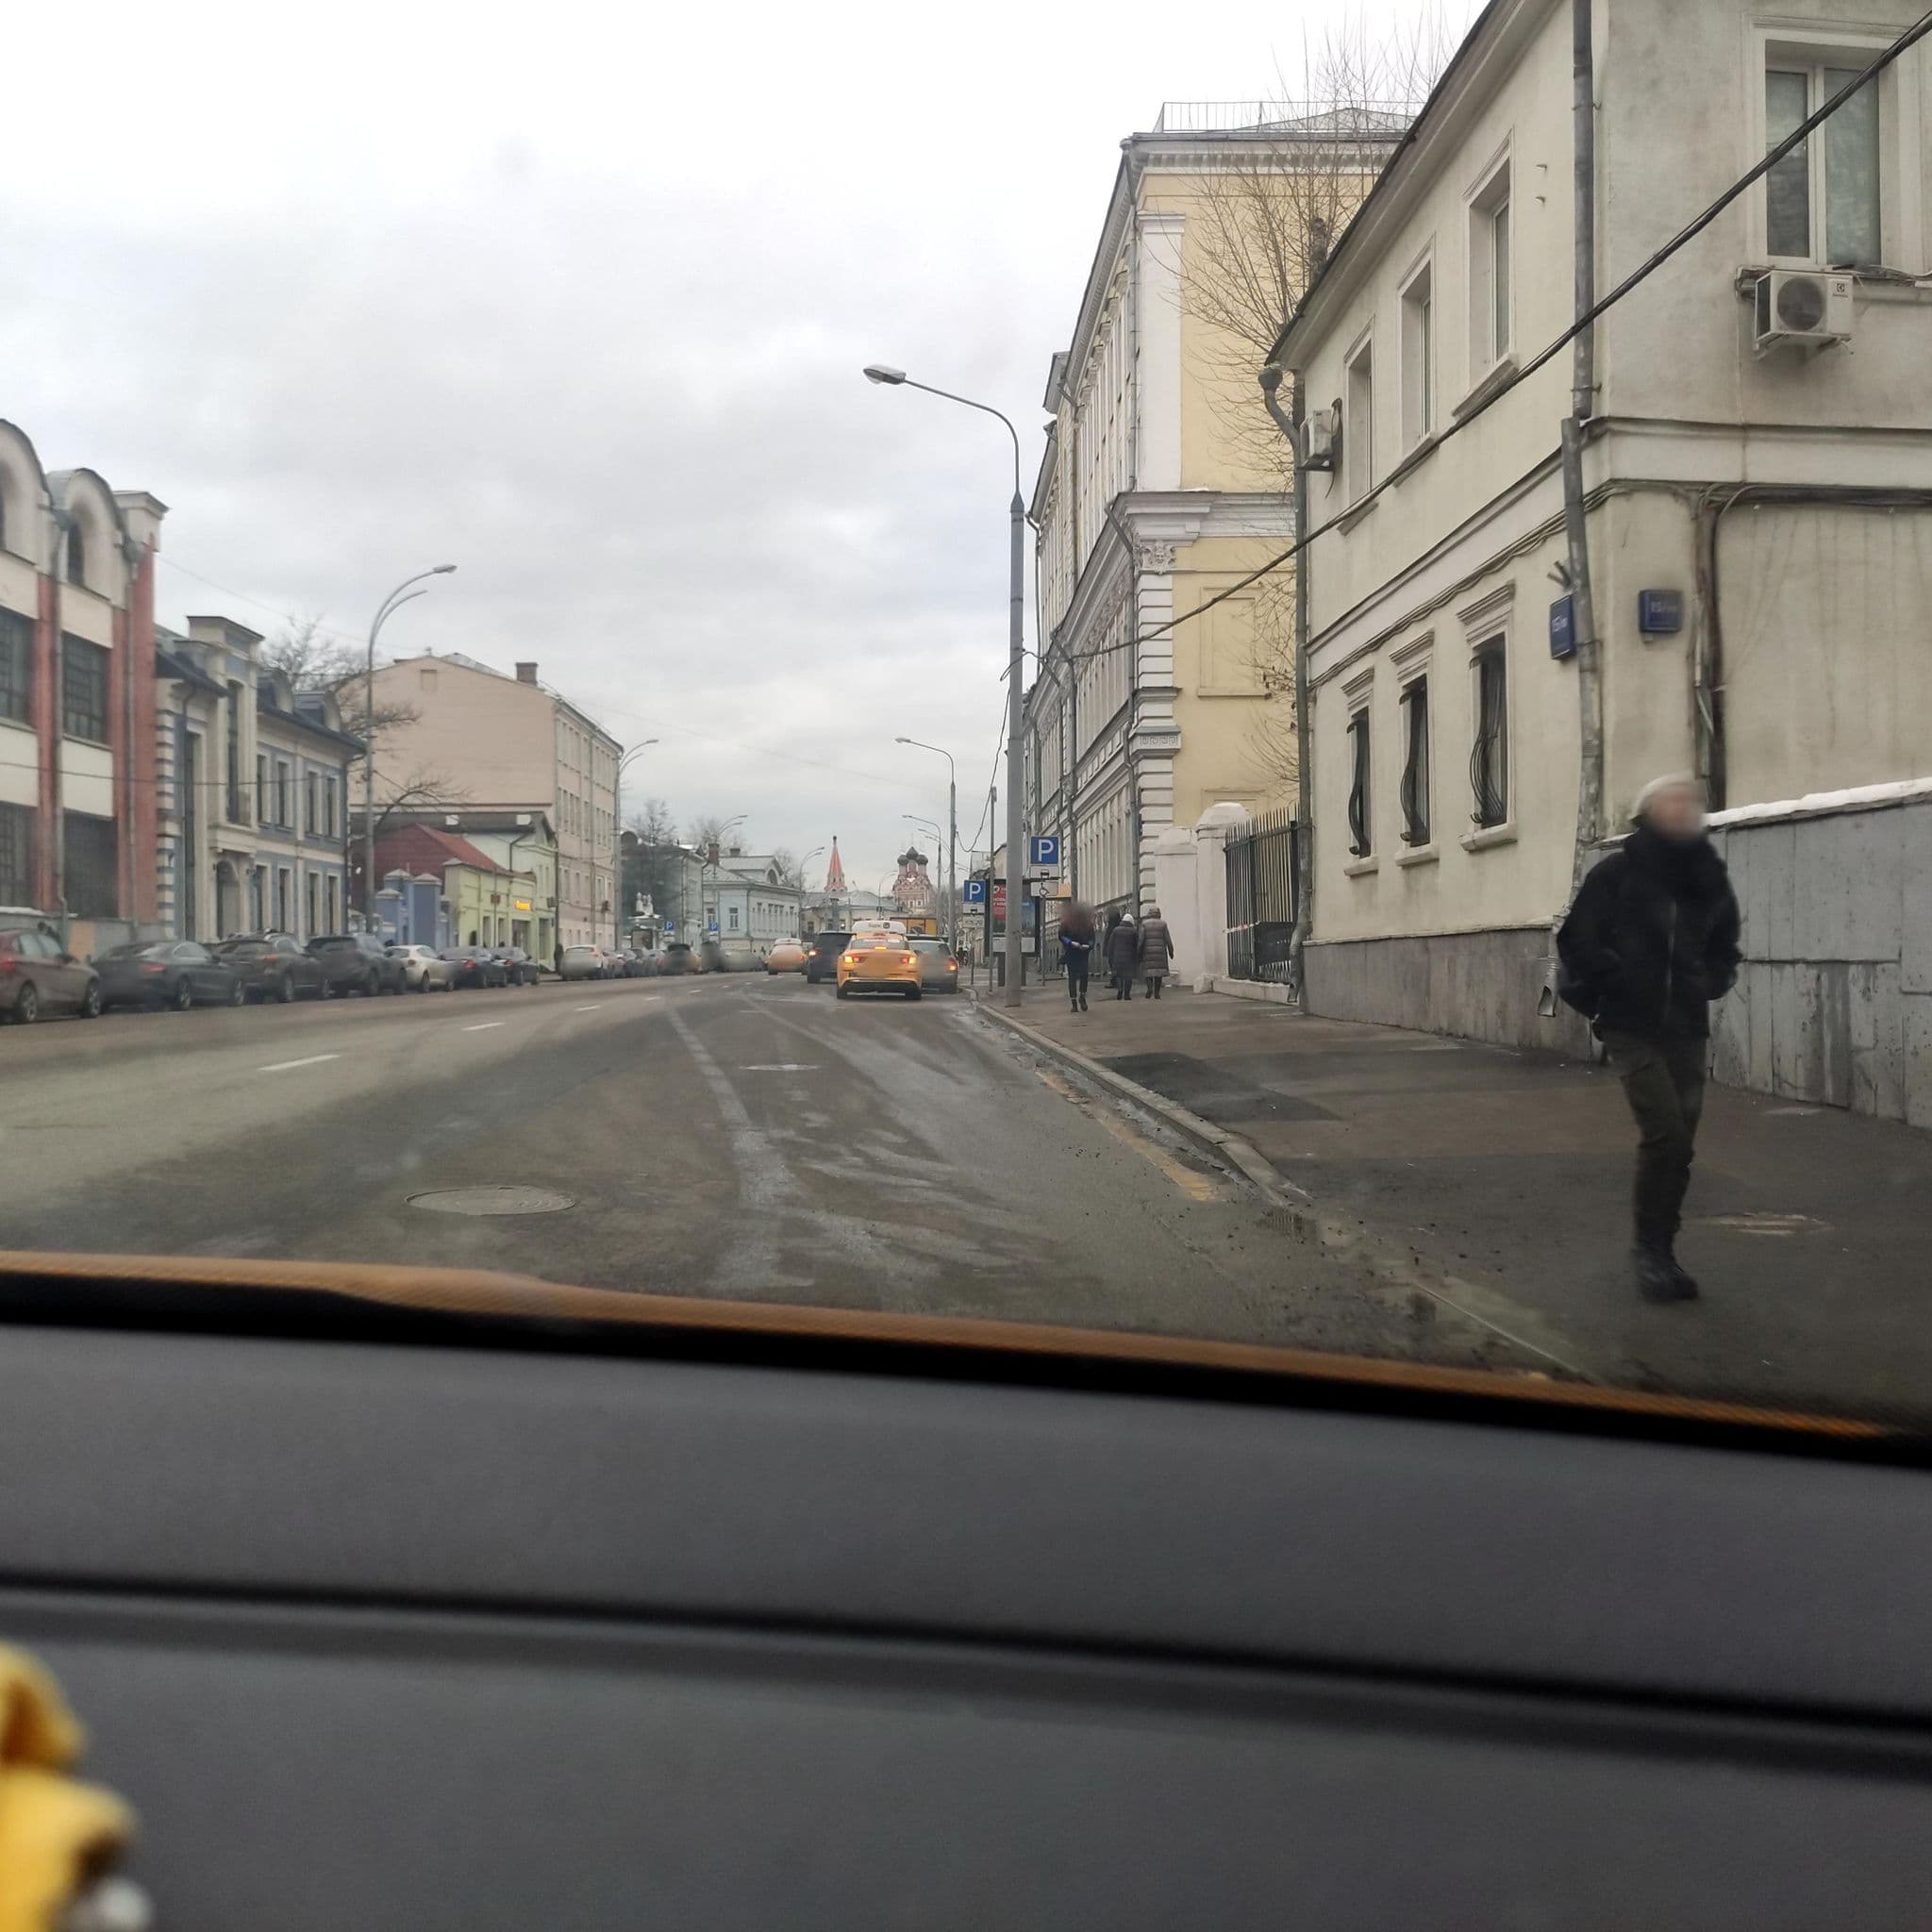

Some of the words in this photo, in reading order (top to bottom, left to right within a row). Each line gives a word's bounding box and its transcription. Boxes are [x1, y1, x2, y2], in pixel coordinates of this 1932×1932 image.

[1038, 839, 1054, 862] P
[969, 883, 982, 900] P
[666, 922, 673, 930] P
